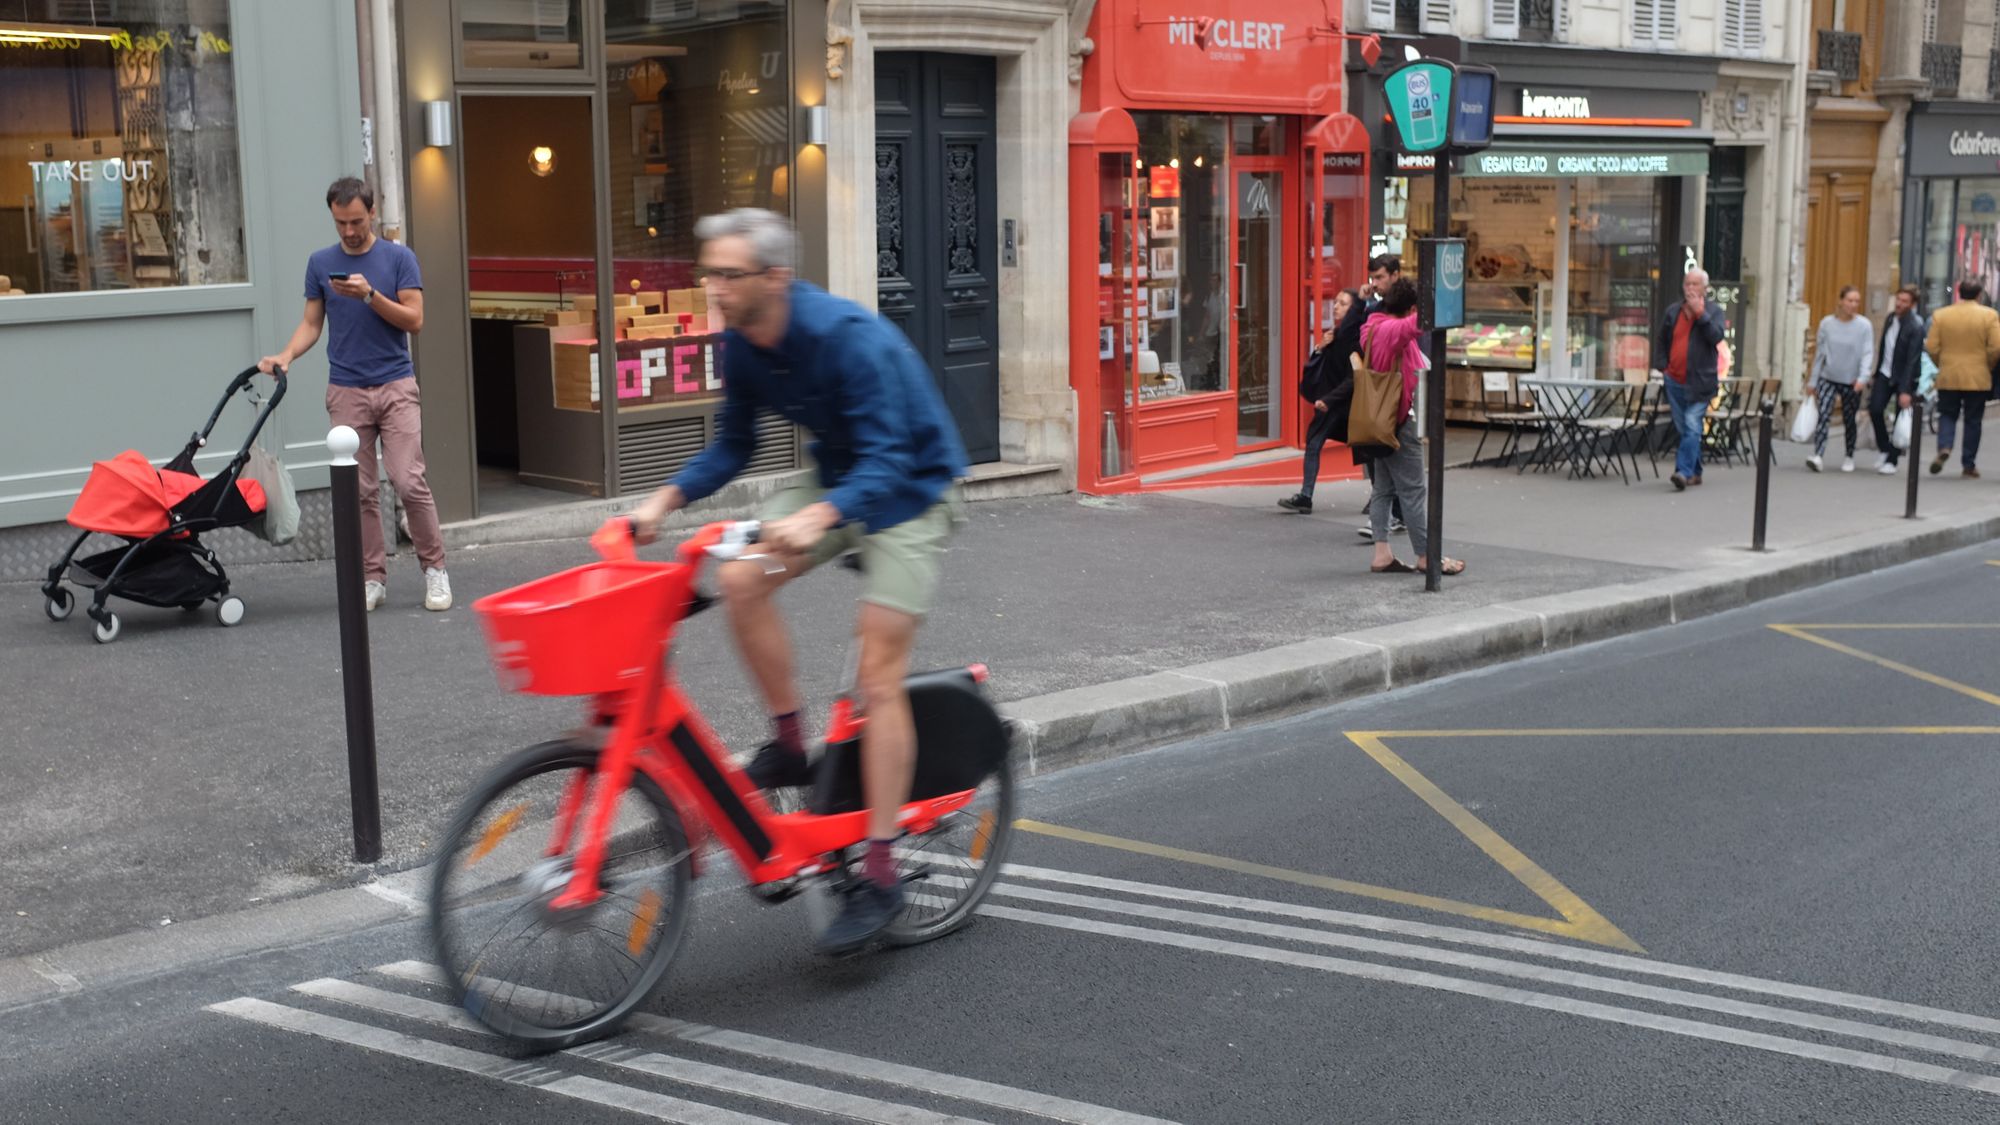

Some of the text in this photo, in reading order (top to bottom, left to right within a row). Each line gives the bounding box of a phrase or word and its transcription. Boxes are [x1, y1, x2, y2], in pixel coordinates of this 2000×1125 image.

[1411, 80, 1427, 90] BUS
[1413, 97, 1429, 110] 40
[28, 160, 152, 182] TAKE OUT
[1480, 155, 1669, 173] VEGAN GELATO ORGANIC FOOD AND COFFEE
[1445, 254, 1464, 274] BUS
